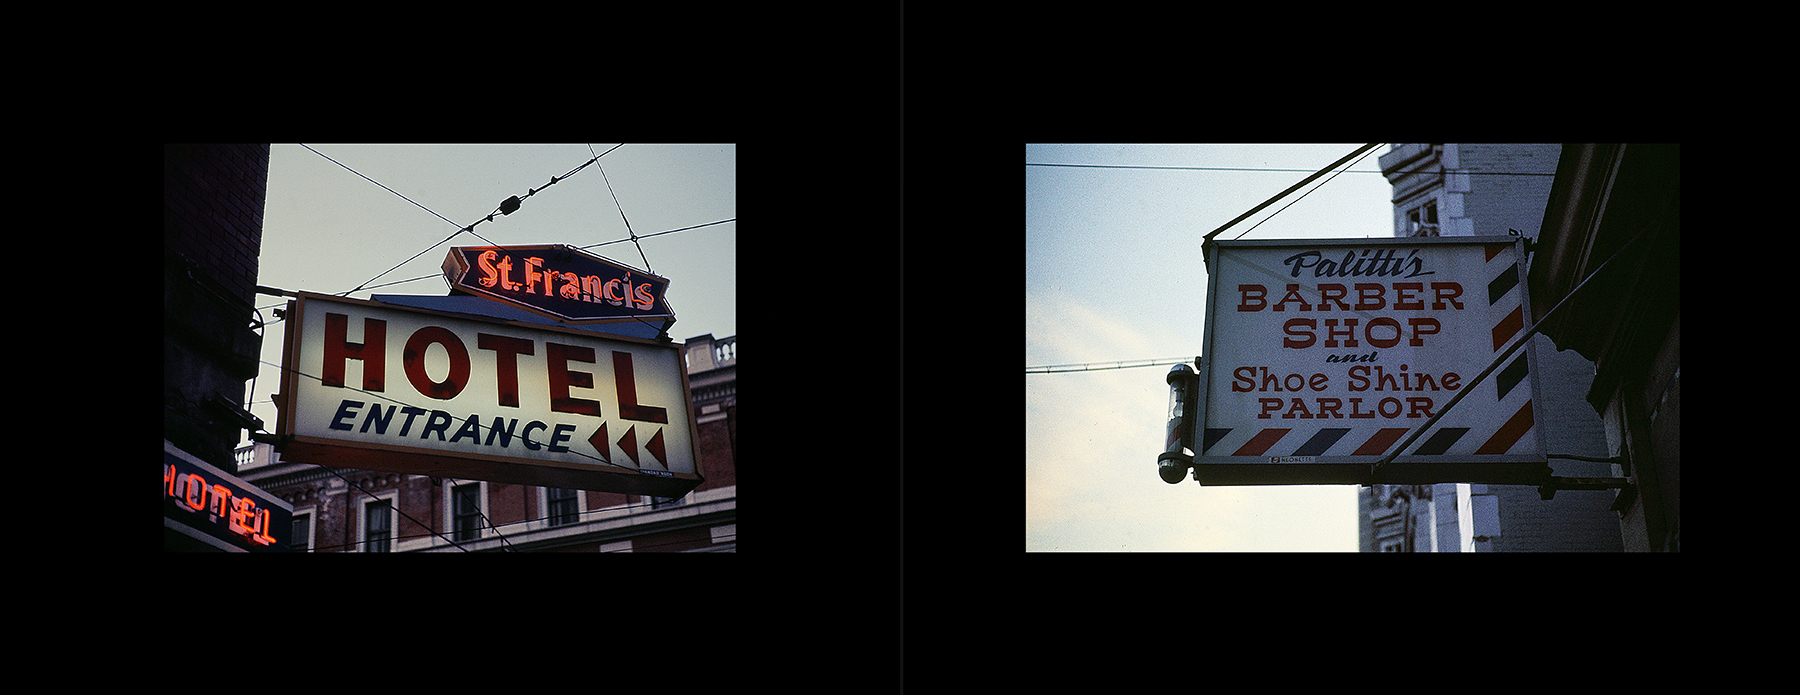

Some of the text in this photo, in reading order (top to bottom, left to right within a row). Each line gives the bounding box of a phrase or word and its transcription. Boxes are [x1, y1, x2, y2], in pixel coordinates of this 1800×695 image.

[1237, 282, 1464, 312] BARBER
[1283, 317, 1441, 349] SHOP
[321, 312, 669, 424] HOTEL
[1326, 351, 1379, 363] and
[1232, 364, 1462, 393] Shoe Shine
[1258, 397, 1435, 419] PARLOR
[329, 399, 577, 453] ENTRANCE
